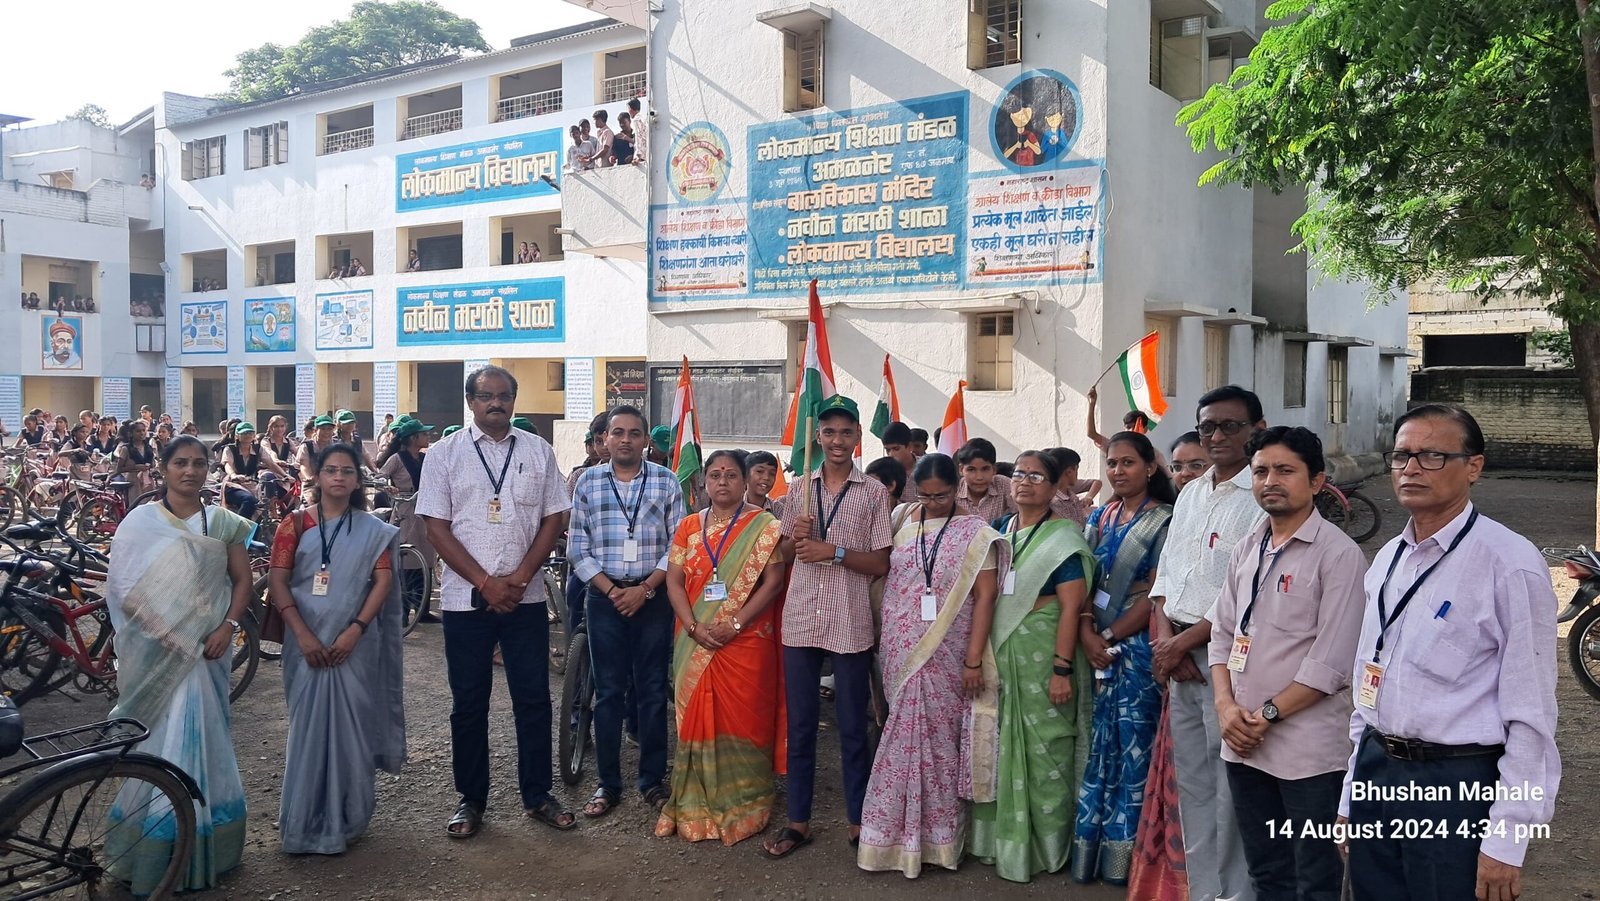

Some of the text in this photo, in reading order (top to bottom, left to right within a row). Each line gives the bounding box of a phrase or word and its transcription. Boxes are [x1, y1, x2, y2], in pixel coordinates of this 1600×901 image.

[758, 113, 957, 161] लोकमान्य शिक्षण मंडळ
[401, 151, 558, 200] लोकमान्य विद्यालय
[812, 151, 893, 182] अमळनेर
[787, 174, 936, 212] बालविकास मंदिर
[1032, 191, 1039, 202] व
[1066, 184, 1091, 199] विभाग
[787, 205, 948, 239] नवीन मराठी शाळा
[972, 200, 1094, 229] प्रत्येक मूल शाळेत जाईल
[656, 237, 679, 251] शिक्षण
[680, 234, 707, 252] हक्काची
[787, 233, 956, 265] लोकमान्य विद्यालय
[971, 232, 1001, 252] एकही
[1005, 235, 1025, 251] मूल
[1027, 229, 1047, 247] घरी
[1048, 233, 1058, 245] न
[659, 250, 745, 270] शिक्षणगंगा आता घरोघरी
[403, 297, 556, 334] नवीन मराठी शाळा
